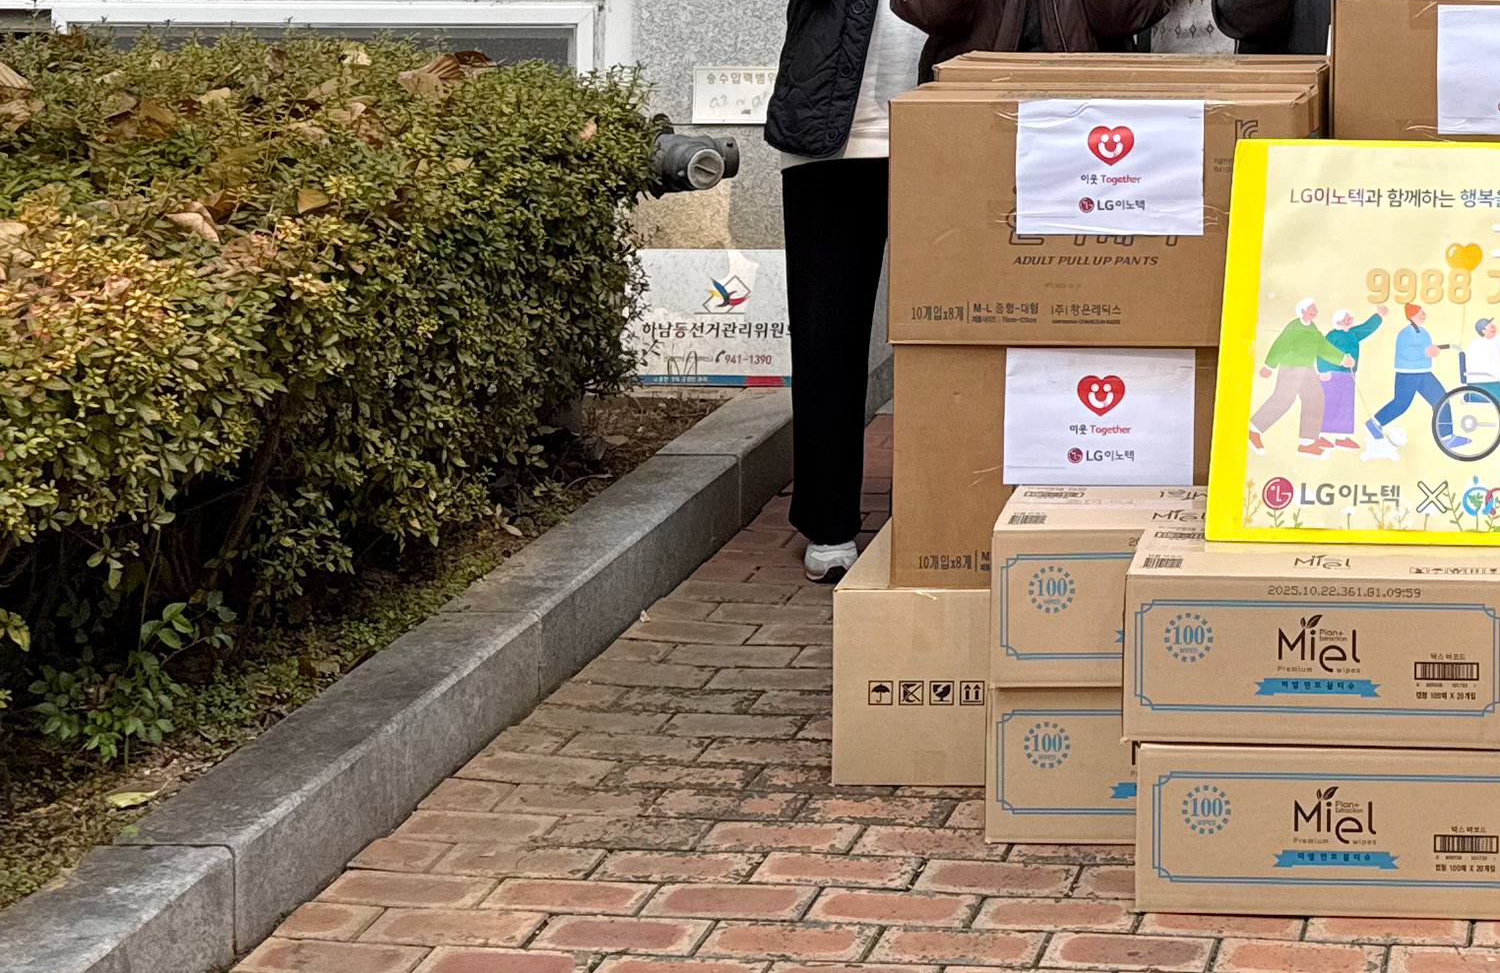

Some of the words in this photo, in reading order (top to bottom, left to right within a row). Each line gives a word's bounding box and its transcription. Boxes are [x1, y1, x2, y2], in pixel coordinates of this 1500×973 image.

[1080, 174, 1098, 185] 이웃
[1100, 174, 1142, 186] Together
[1290, 188, 1383, 207] LG이노텍과
[1387, 189, 1456, 208] 함께하는
[1013, 256, 1055, 266] ADULT
[1114, 256, 1159, 266] PANTS
[1366, 268, 1472, 304] 9988
[973, 303, 992, 313] M-L
[724, 354, 772, 365] 941-1390
[1069, 424, 1087, 435] 이웃
[1090, 425, 1131, 436] Together
[1300, 482, 1400, 506] LG이노텍
[1036, 578, 1068, 597] 100
[1174, 625, 1206, 645] 100
[1278, 628, 1361, 673] Miel
[1031, 734, 1062, 753] 100
[1190, 798, 1223, 817] 100
[1294, 800, 1377, 844] Miel
